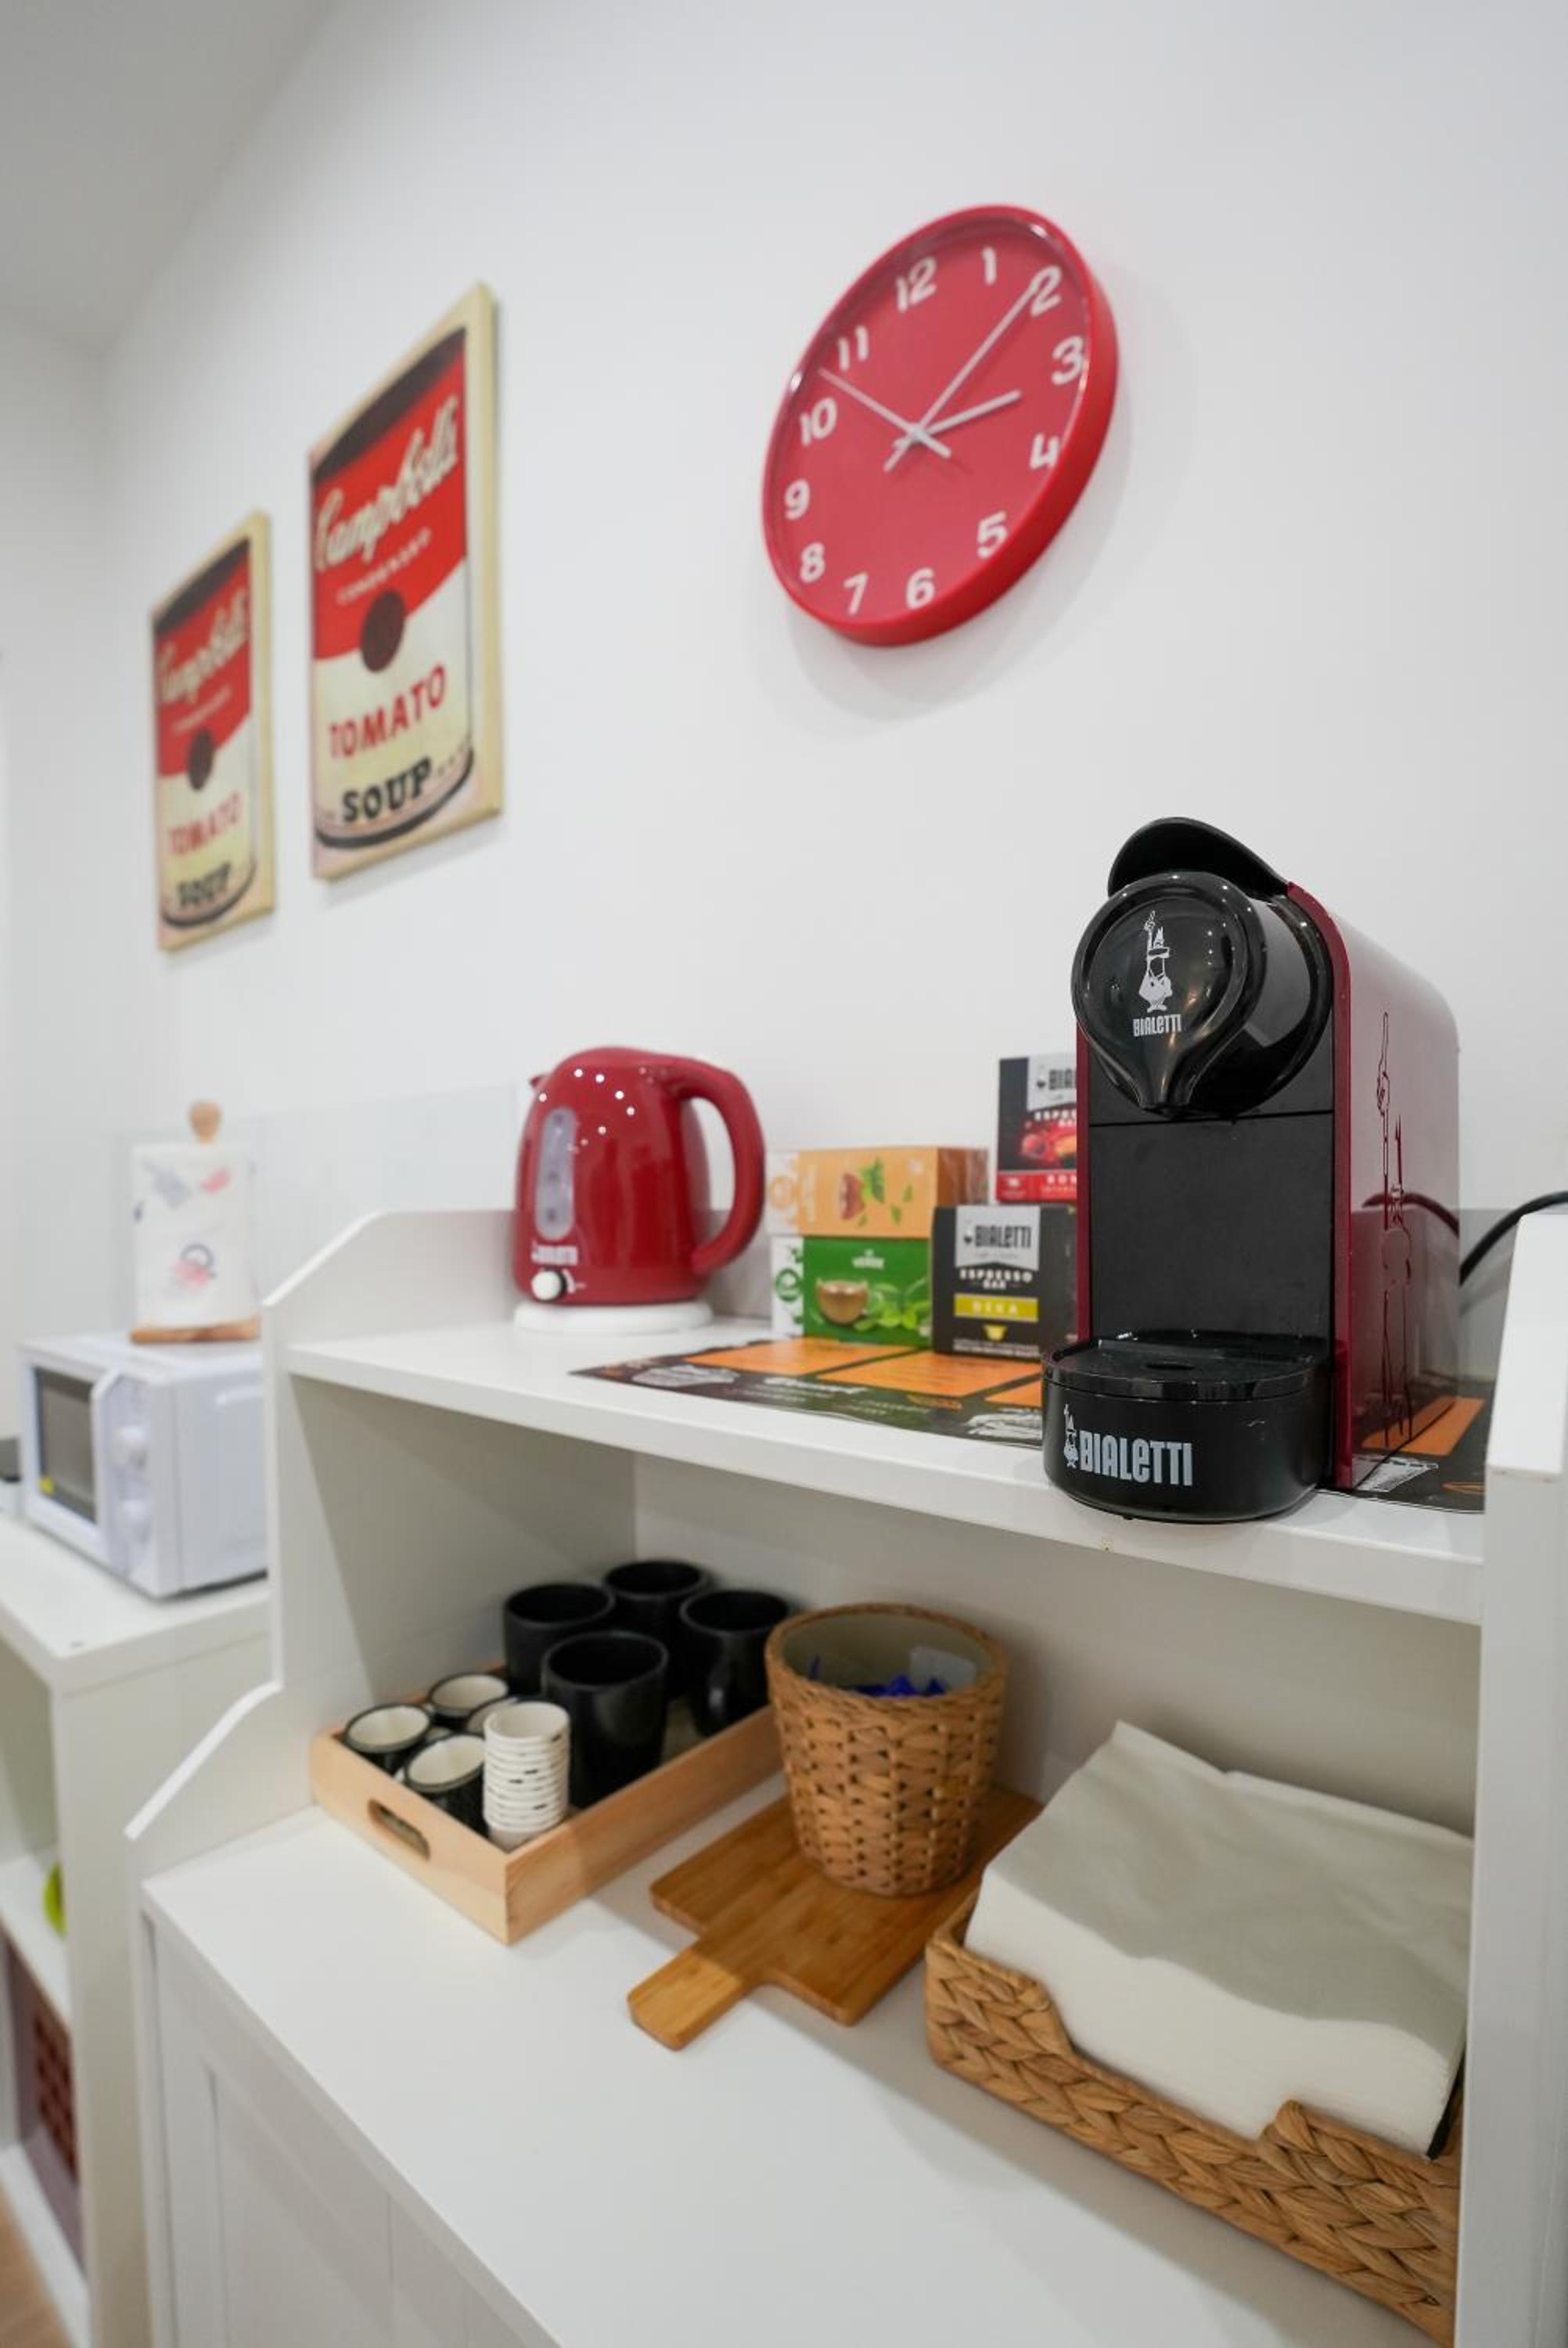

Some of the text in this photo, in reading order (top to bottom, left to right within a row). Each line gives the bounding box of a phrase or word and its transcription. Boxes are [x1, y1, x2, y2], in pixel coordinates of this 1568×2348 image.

[895, 257, 937, 313] 12
[981, 246, 997, 286] 1
[1031, 265, 1062, 317] 2
[838, 325, 869, 372] 11
[1051, 335, 1084, 387] 3
[800, 396, 837, 447] 10
[1028, 432, 1059, 471] 4
[783, 479, 811, 521] 9
[976, 510, 1008, 559] 5
[799, 542, 826, 584] 8
[843, 572, 869, 616] 7
[905, 567, 936, 610] 6
[328, 663, 446, 758] TOMATO
[342, 756, 431, 825] SOUP
